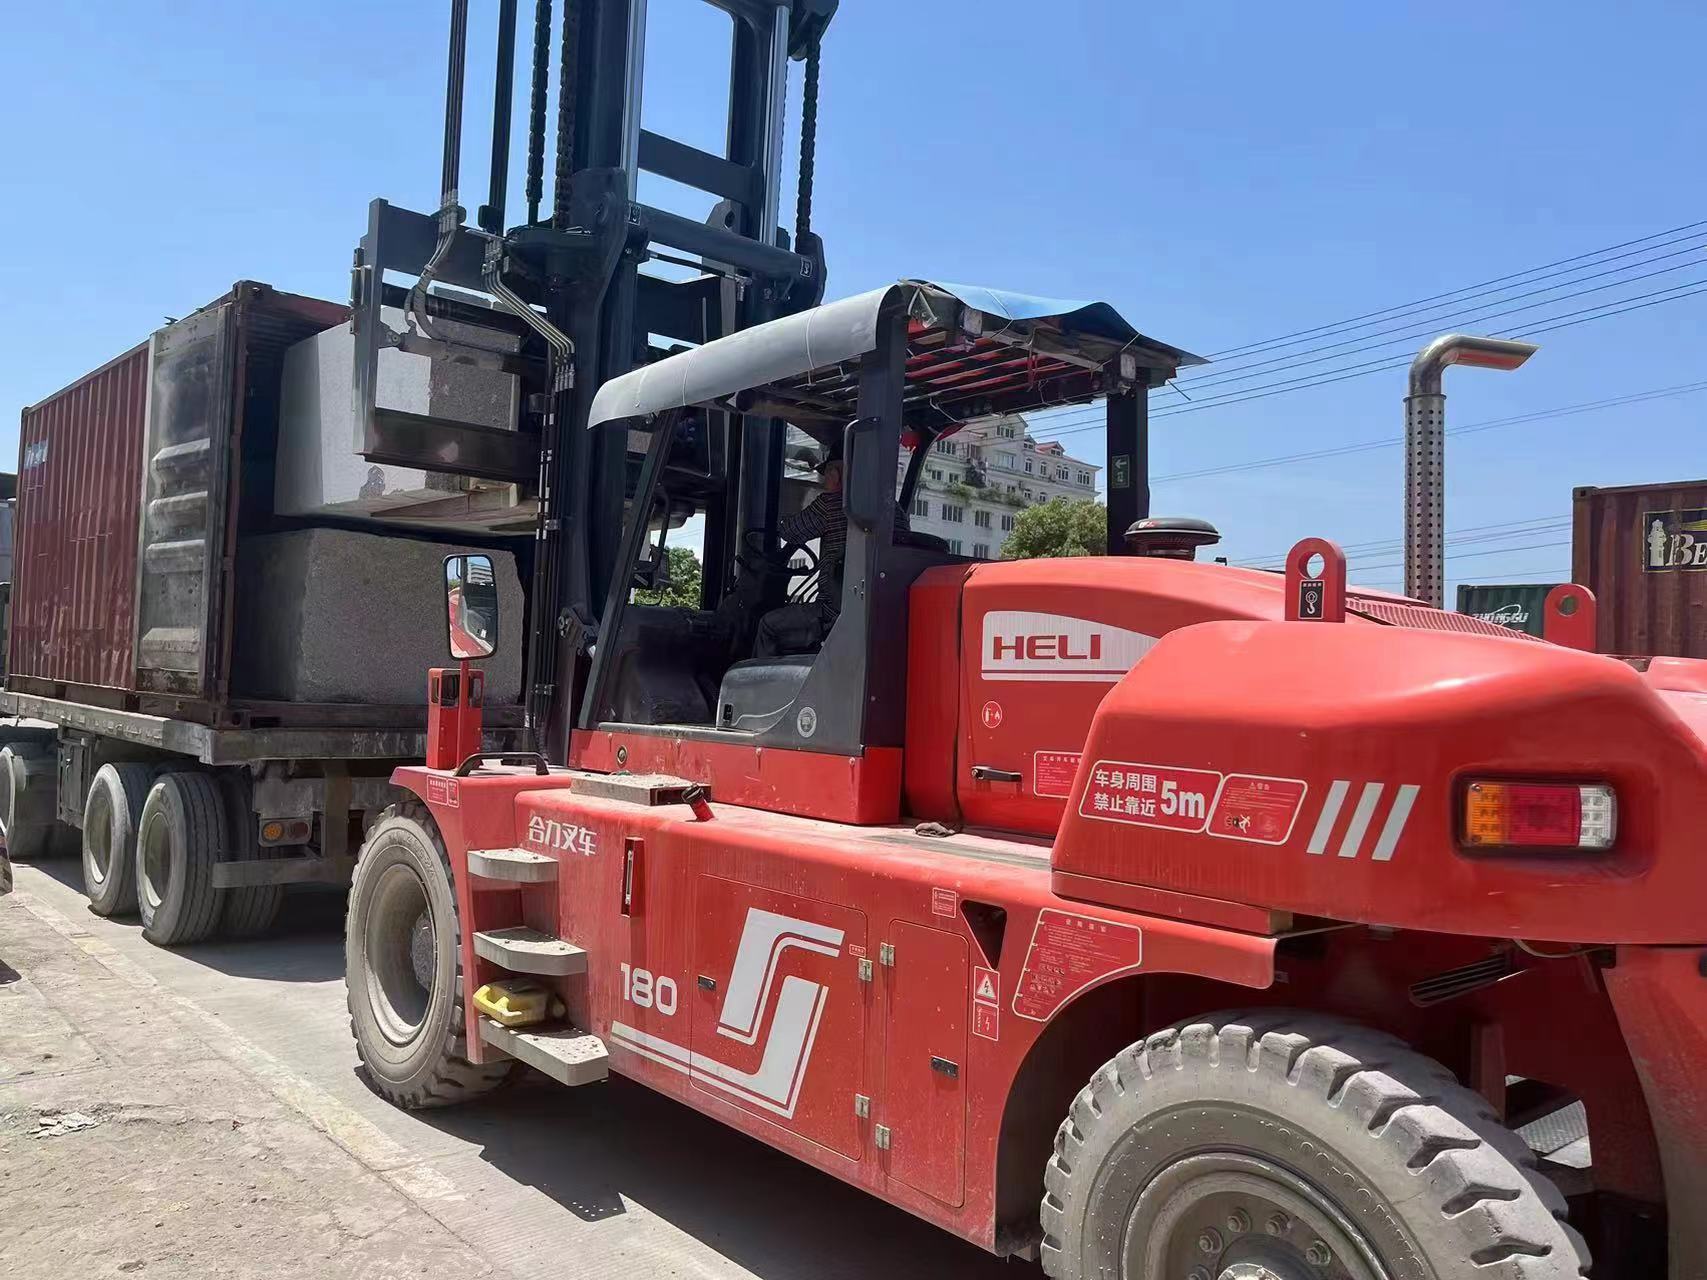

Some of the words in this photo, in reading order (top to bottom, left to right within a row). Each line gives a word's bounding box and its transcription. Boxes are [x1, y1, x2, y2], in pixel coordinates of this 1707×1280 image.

[993, 634, 1101, 660] HELI
[1094, 768, 1157, 794] 车身周围
[1093, 792, 1156, 817] 禁止靠近
[1160, 780, 1206, 819] 5m
[528, 815, 597, 857] 合力叉车
[620, 962, 678, 1016] 180
